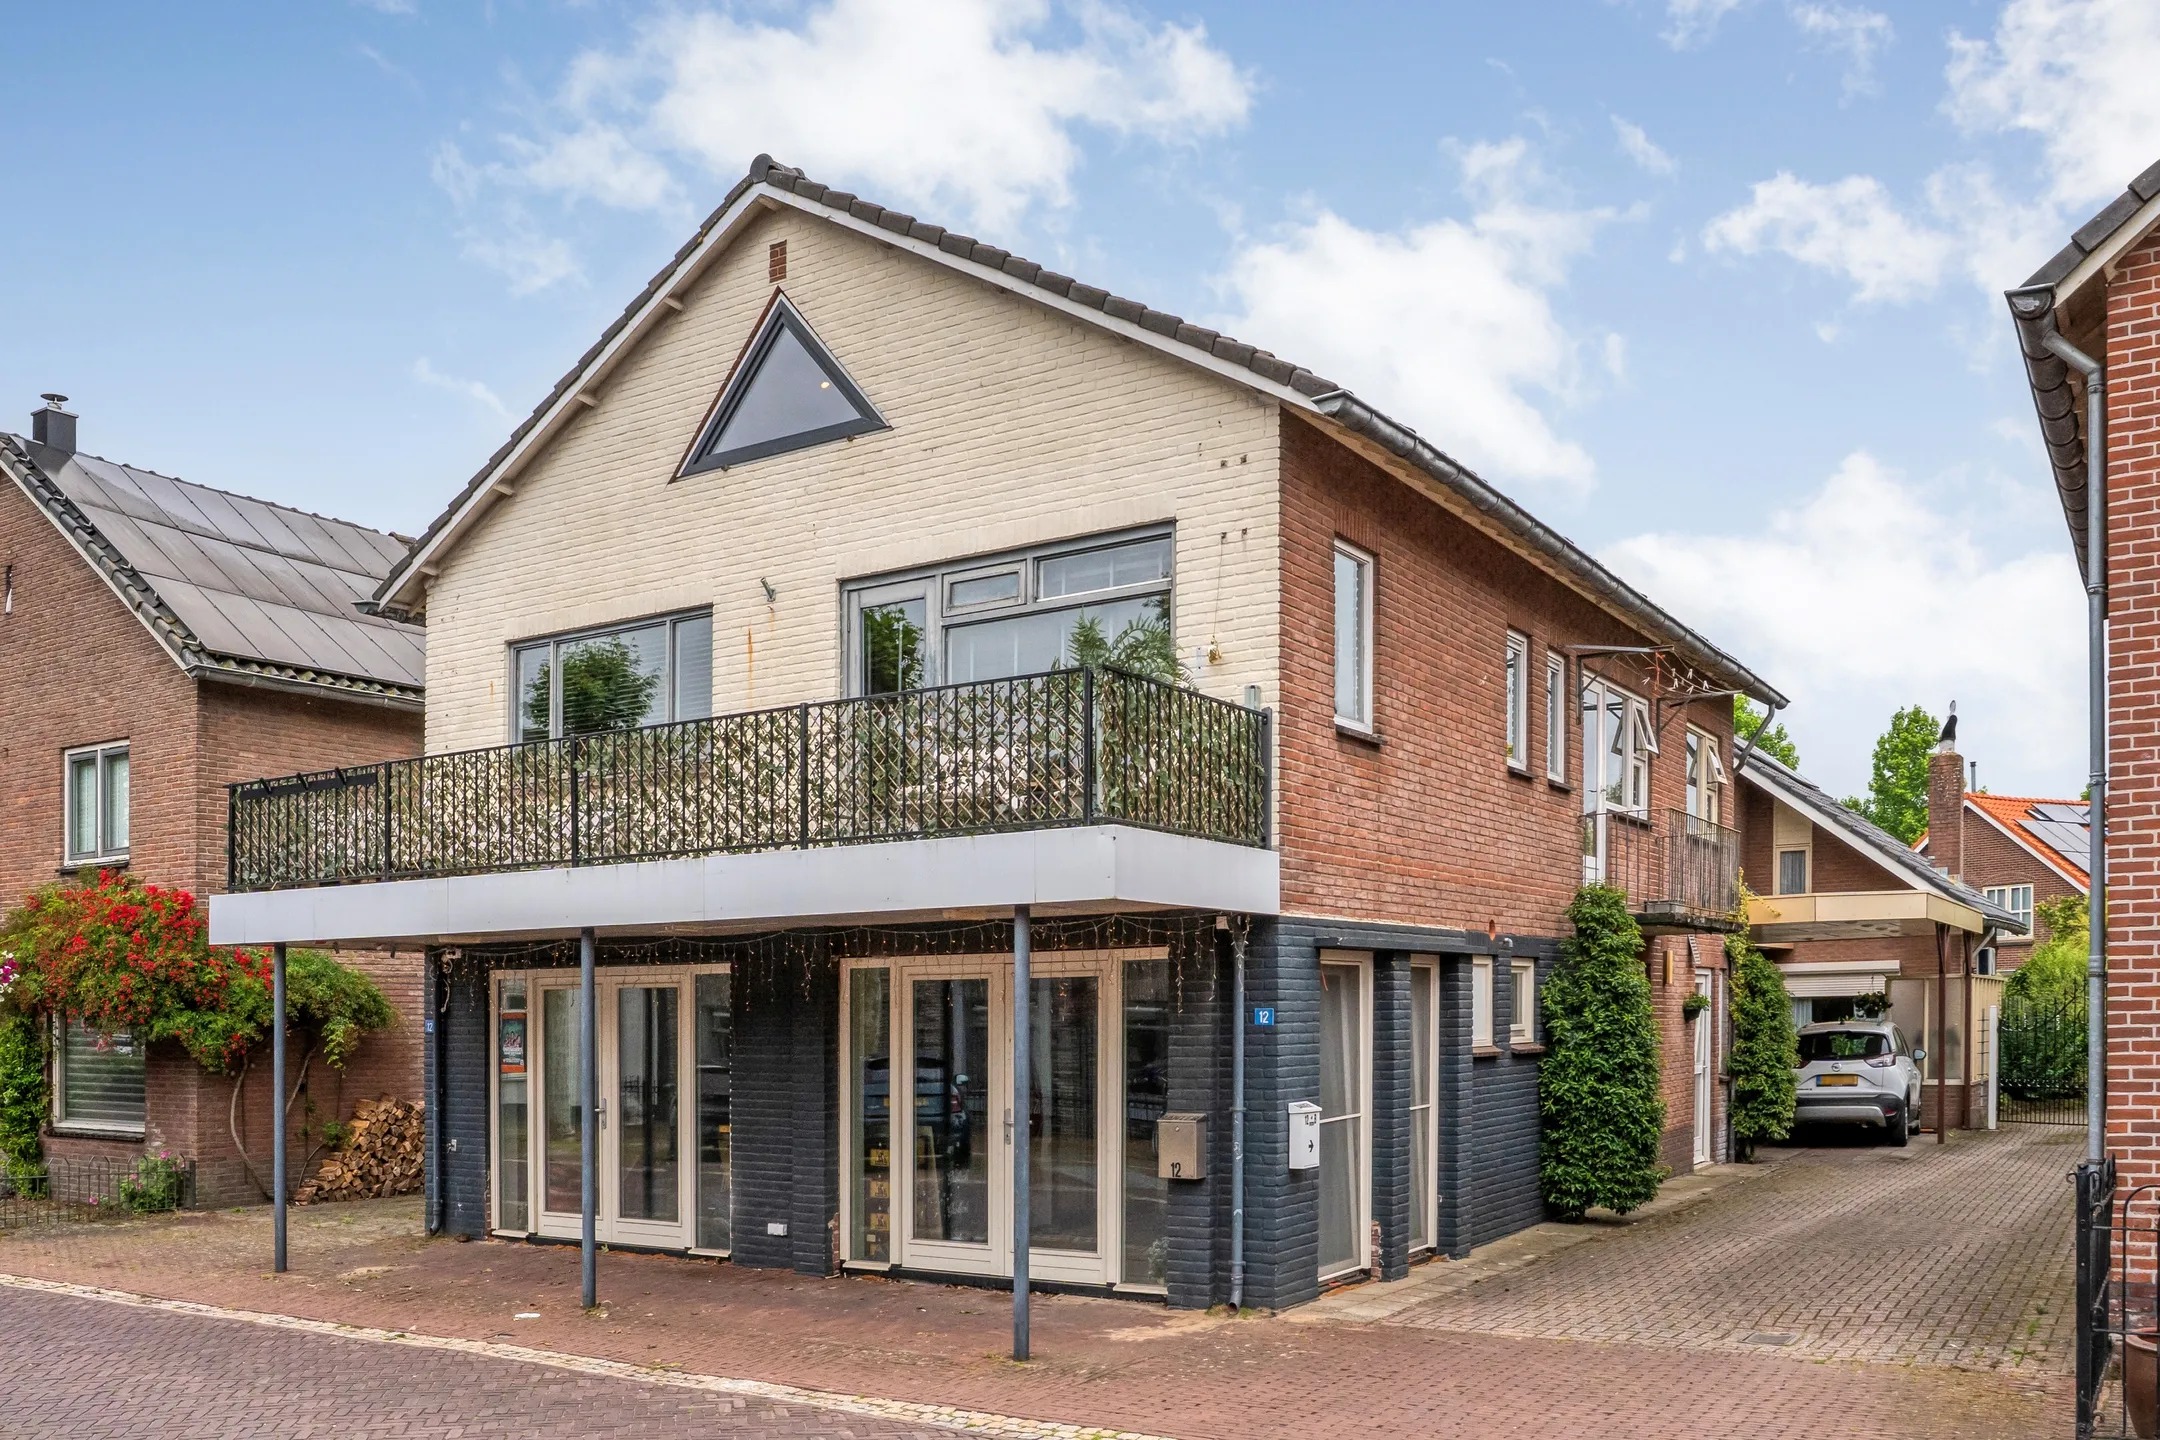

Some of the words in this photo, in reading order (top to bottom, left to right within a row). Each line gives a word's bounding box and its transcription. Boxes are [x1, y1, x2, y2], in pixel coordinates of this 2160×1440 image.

[1259, 1010, 1269, 1024] 12
[427, 1022, 433, 1032] 12
[1170, 1162, 1182, 1178] 12
